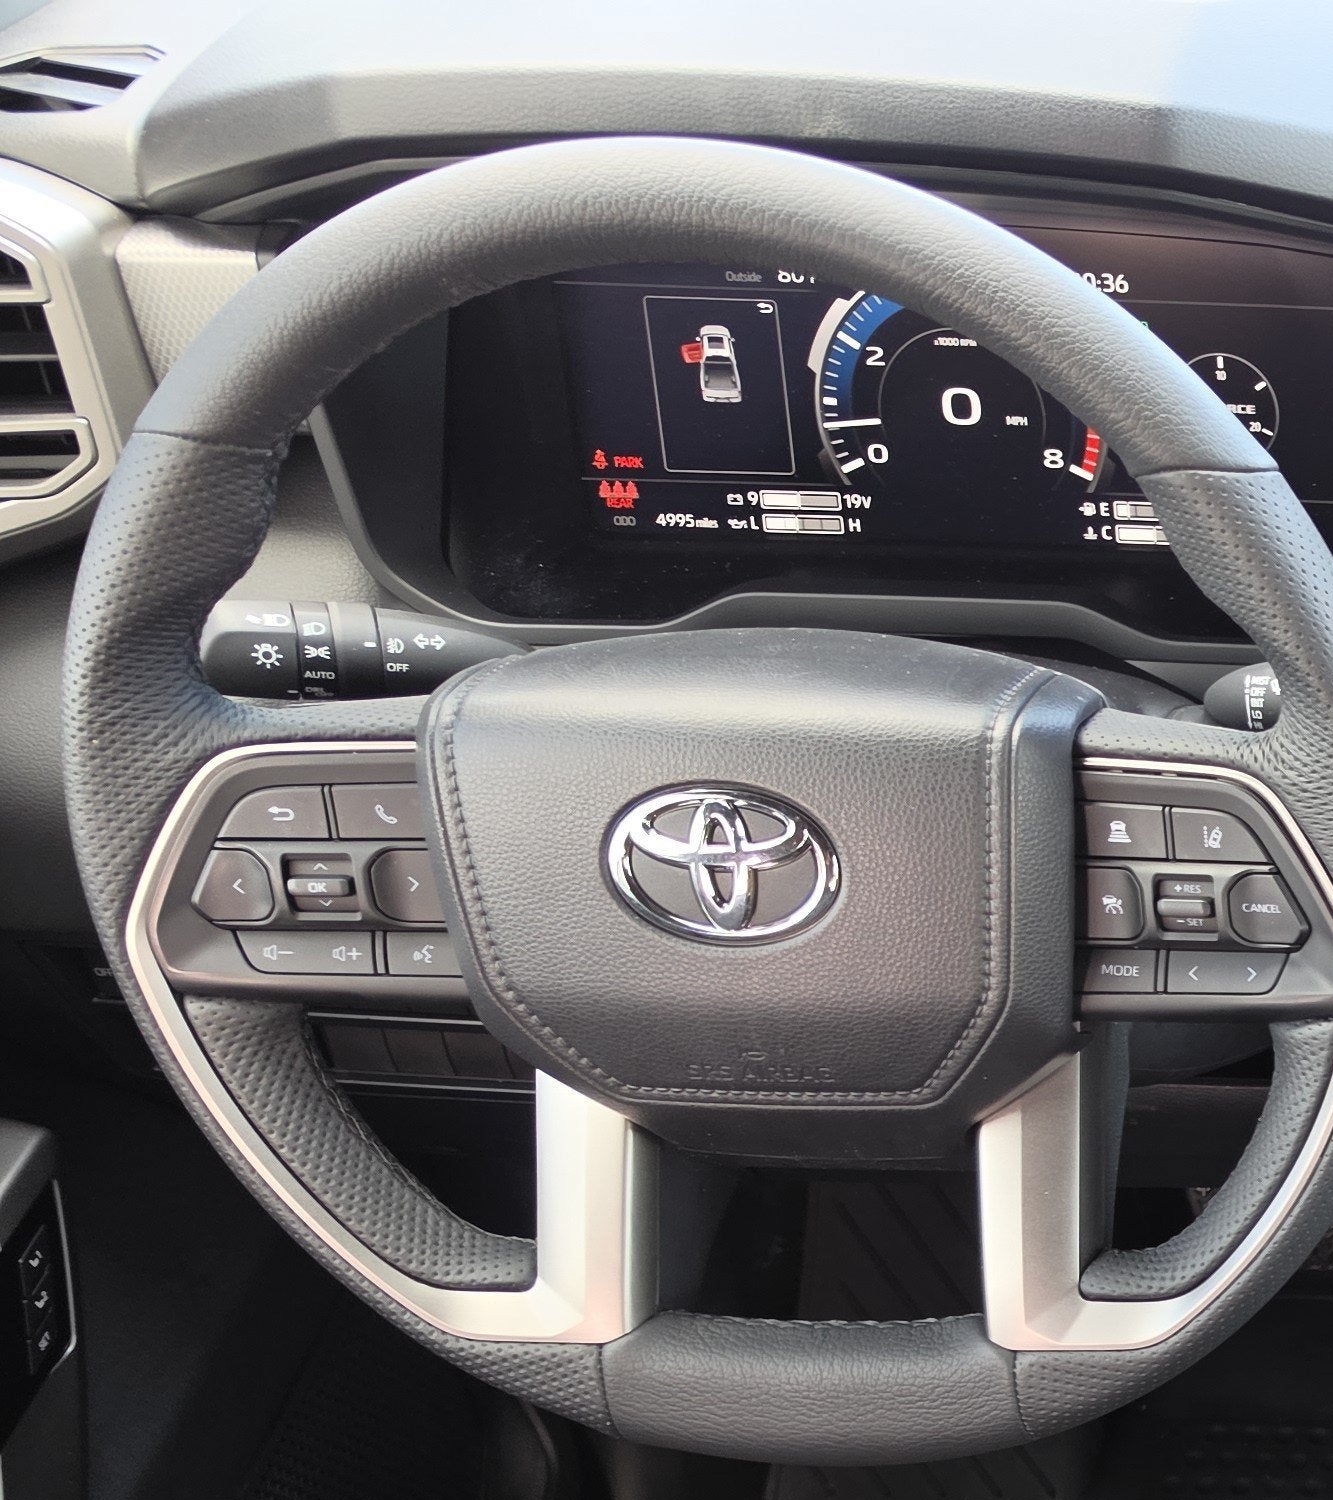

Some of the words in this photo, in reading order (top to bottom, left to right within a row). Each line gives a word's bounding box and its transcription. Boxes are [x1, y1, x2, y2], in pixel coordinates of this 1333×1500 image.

[725, 271, 763, 284] Outside
[1081, 272, 1130, 294] 0:36
[865, 345, 886, 367] 2
[1214, 370, 1227, 381] 10
[941, 387, 982, 426] 0
[1005, 415, 1028, 426] MPH
[1249, 421, 1262, 433] 20
[866, 443, 889, 464] 0
[1042, 449, 1065, 469] 8
[747, 491, 759, 506] 9
[842, 493, 872, 509] 19V
[1100, 502, 1110, 518] E
[655, 513, 694, 528] 4995
[750, 515, 760, 531] L
[848, 518, 862, 533] H
[1101, 526, 1113, 542] C
[386, 662, 410, 672] OFF
[304, 670, 336, 680] AUTO
[307, 881, 328, 894] OK
[1241, 903, 1282, 914] CANCEL
[1100, 963, 1141, 979] MODE
